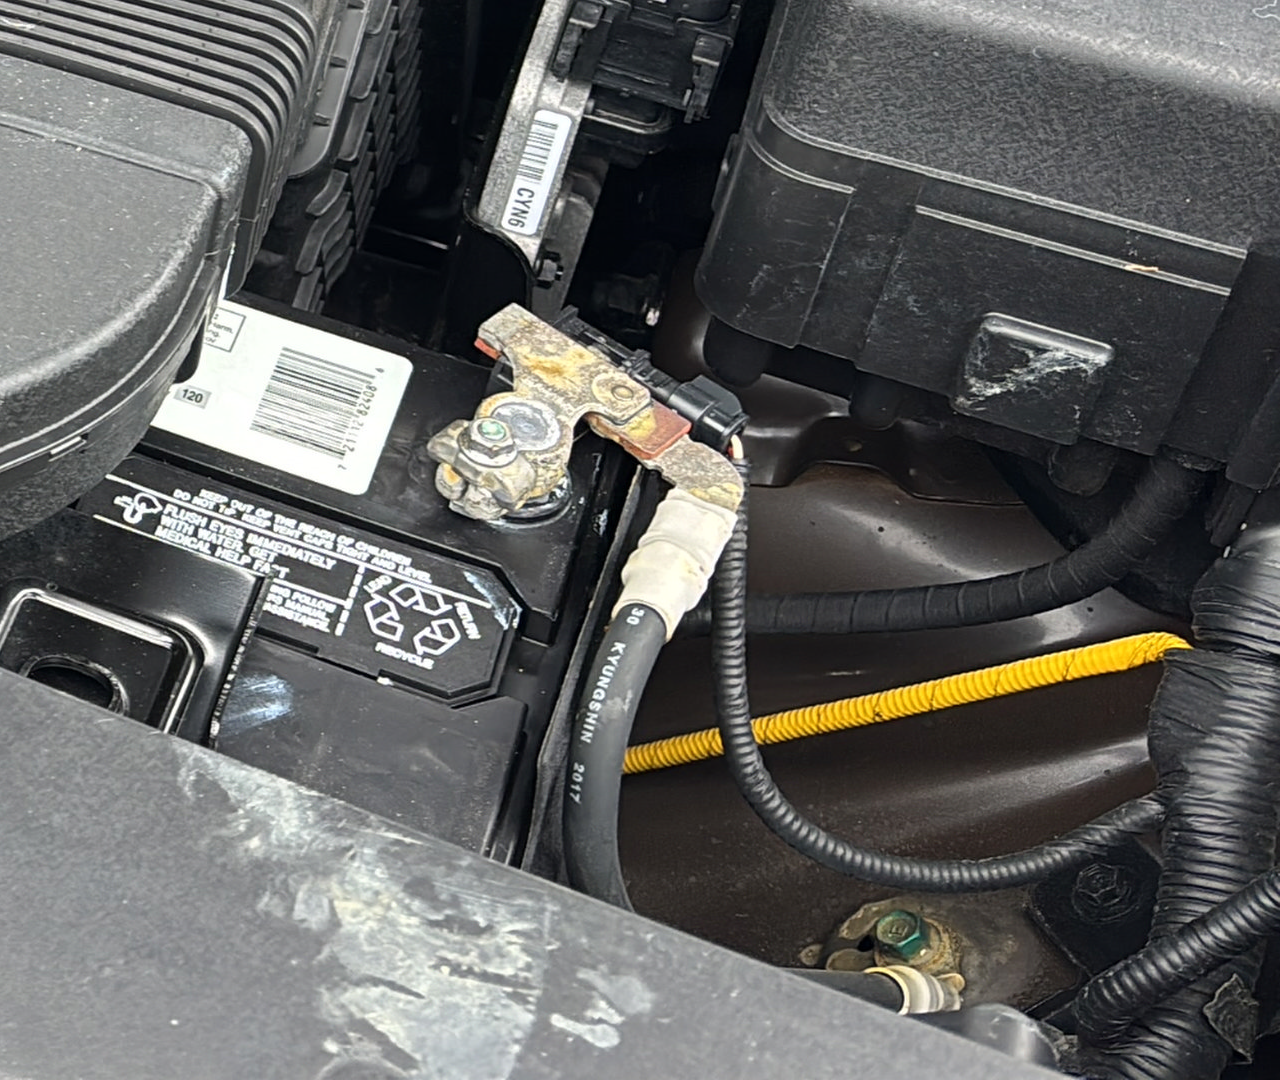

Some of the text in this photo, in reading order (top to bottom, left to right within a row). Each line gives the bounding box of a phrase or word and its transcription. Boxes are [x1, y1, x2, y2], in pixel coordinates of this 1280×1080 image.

[507, 187, 535, 229] CYN6
[182, 388, 204, 404] 120
[160, 515, 196, 536] WITH
[248, 546, 278, 563] GET
[163, 503, 337, 570] FLUSH EYES IMMEDIATELY
[173, 488, 192, 501] DO
[191, 496, 217, 510] NOT
[241, 513, 272, 528] KEEP
[273, 523, 302, 539] VENT
[303, 534, 334, 550] CAPS
[336, 543, 370, 561] TIGHT
[370, 556, 397, 571] AND
[199, 488, 229, 504] KEEP
[230, 499, 256, 514] OUT
[255, 508, 273, 520] OF
[274, 514, 298, 529] THE
[297, 522, 337, 542] REACH
[337, 535, 355, 547] OF
[154, 525, 212, 555] MEDICAL
[214, 546, 253, 566] HELP
[291, 591, 337, 613] FOLLOW
[454, 602, 482, 640] RETURN
[374, 641, 435, 670] RECYCLE
[579, 641, 627, 744] KYUNGSHIN
[568, 761, 586, 805] 2017
